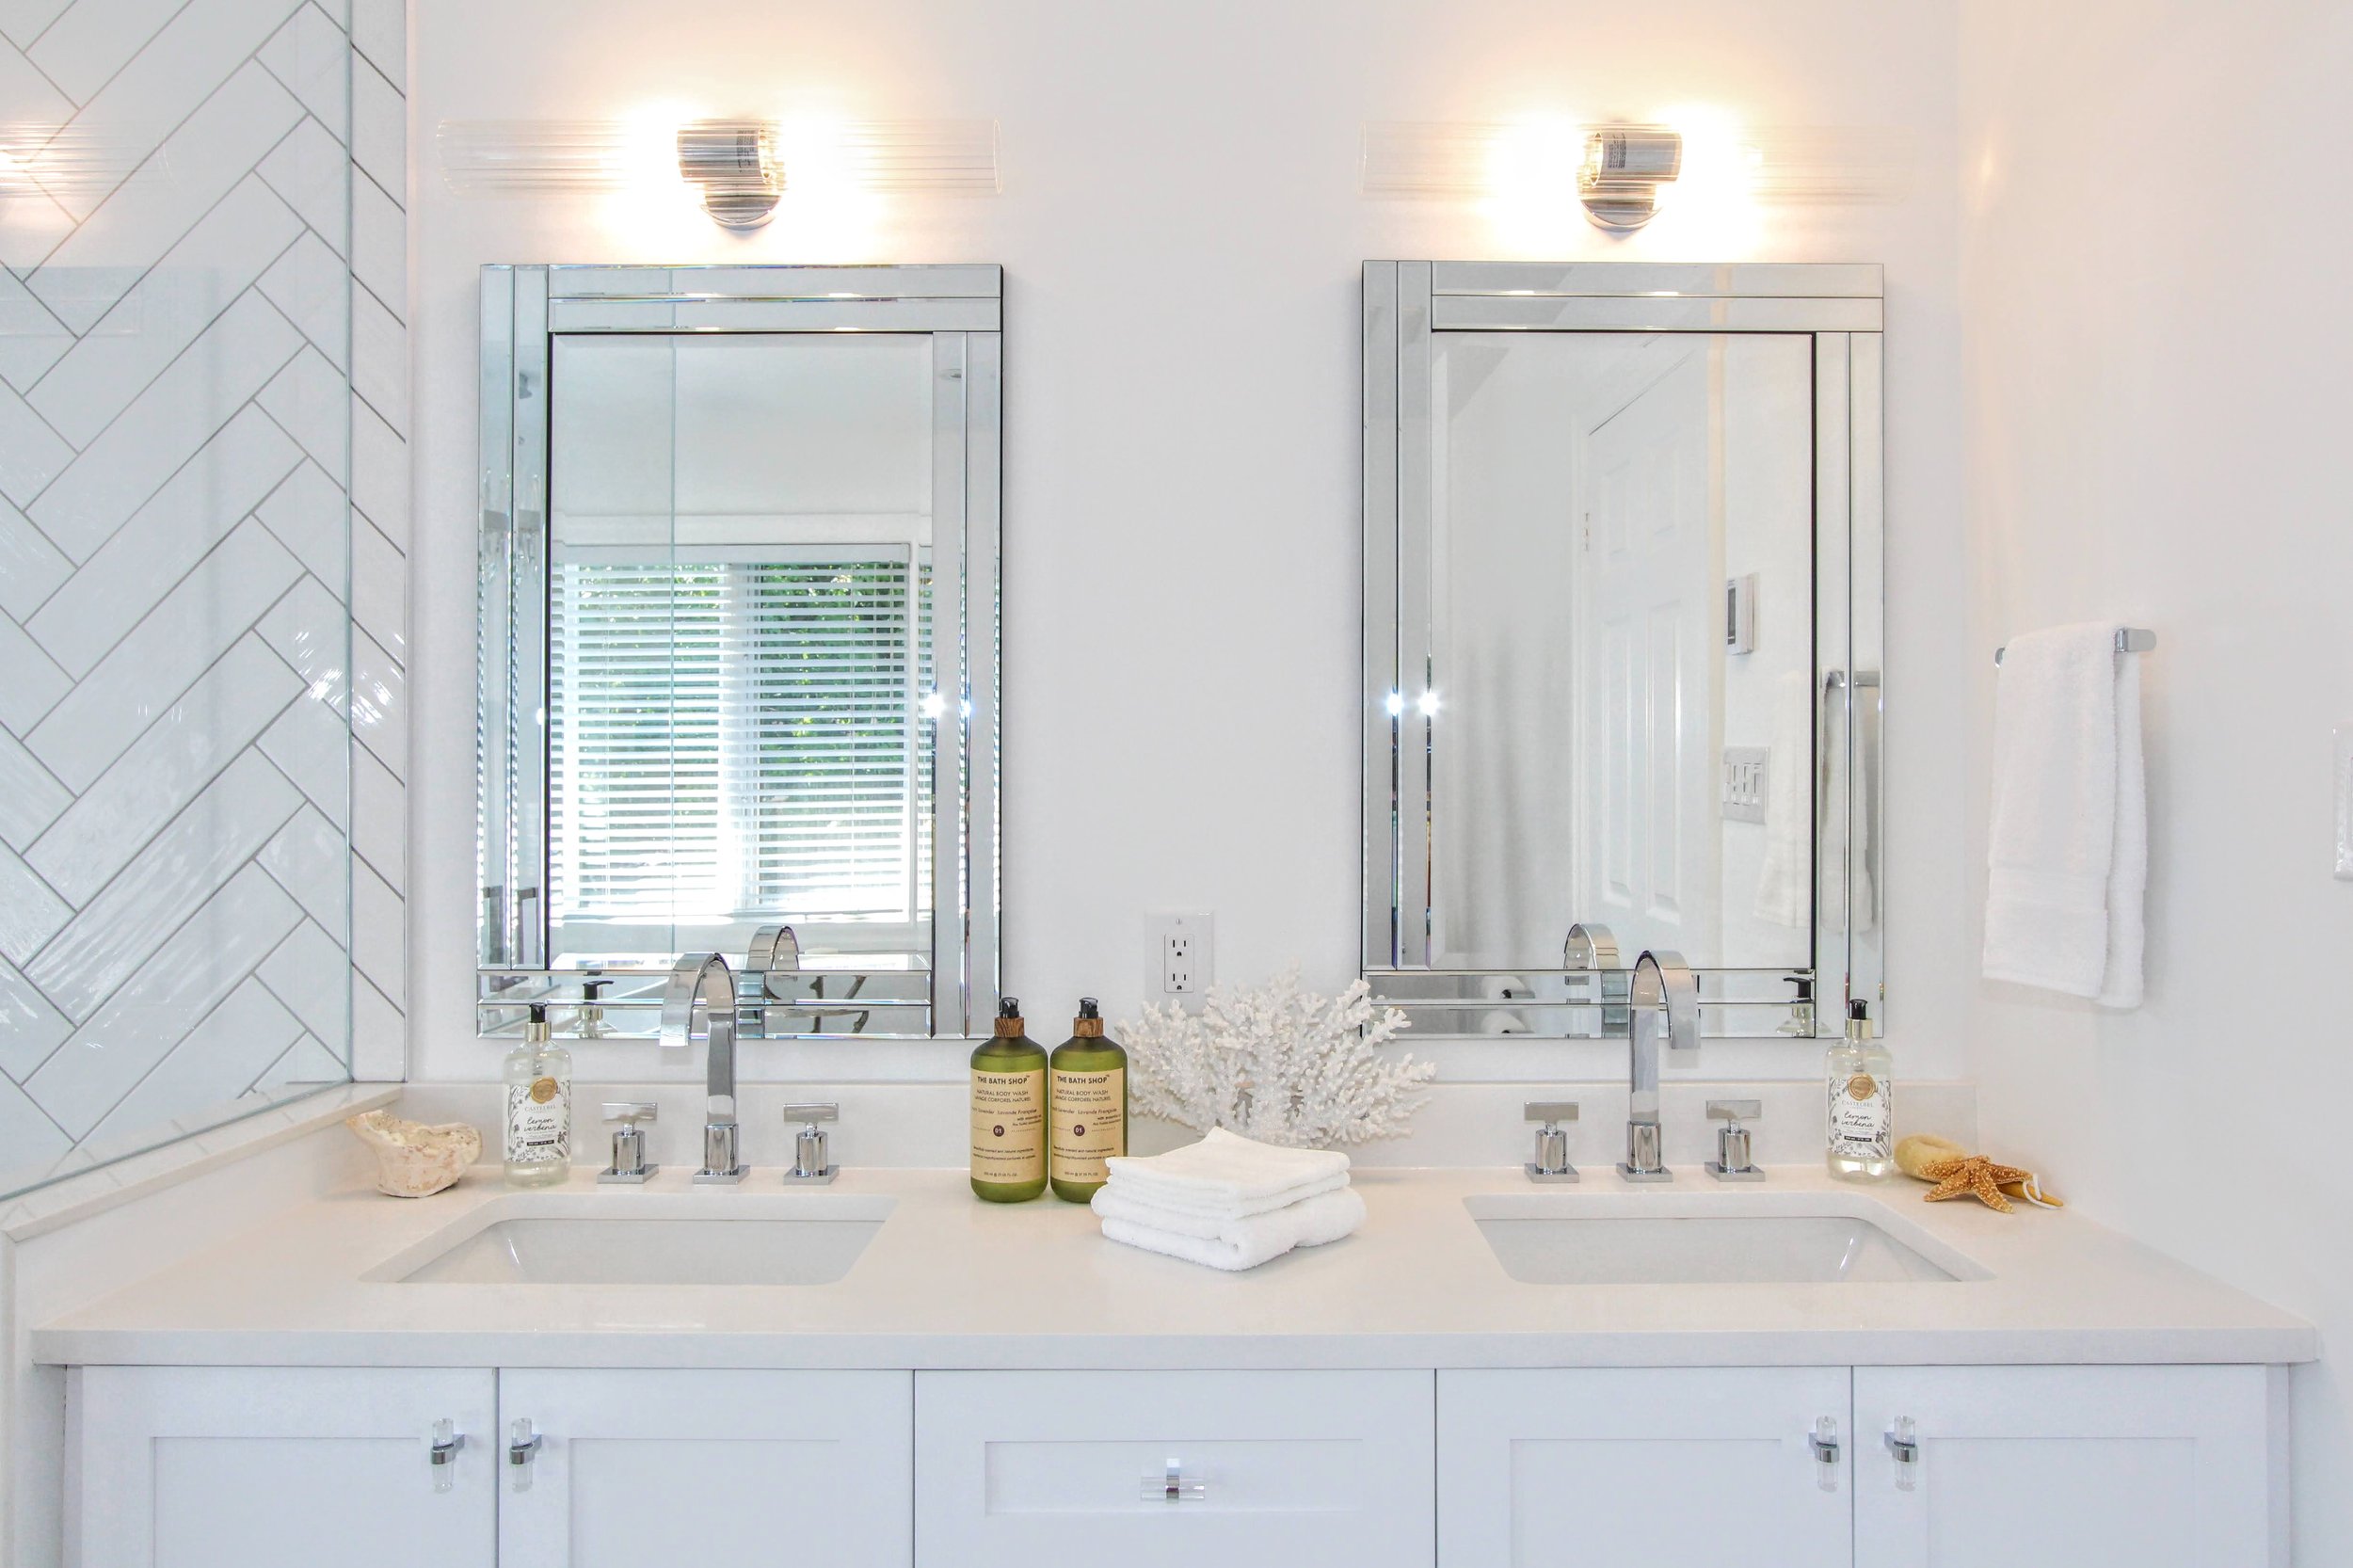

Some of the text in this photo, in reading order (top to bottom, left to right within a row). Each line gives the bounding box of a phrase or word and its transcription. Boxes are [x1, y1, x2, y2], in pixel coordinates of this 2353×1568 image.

[1844, 1111, 1872, 1120] lemon
[527, 1116, 554, 1125] lemon
[1841, 1118, 1875, 1128] verbena
[524, 1121, 557, 1131] verbena
